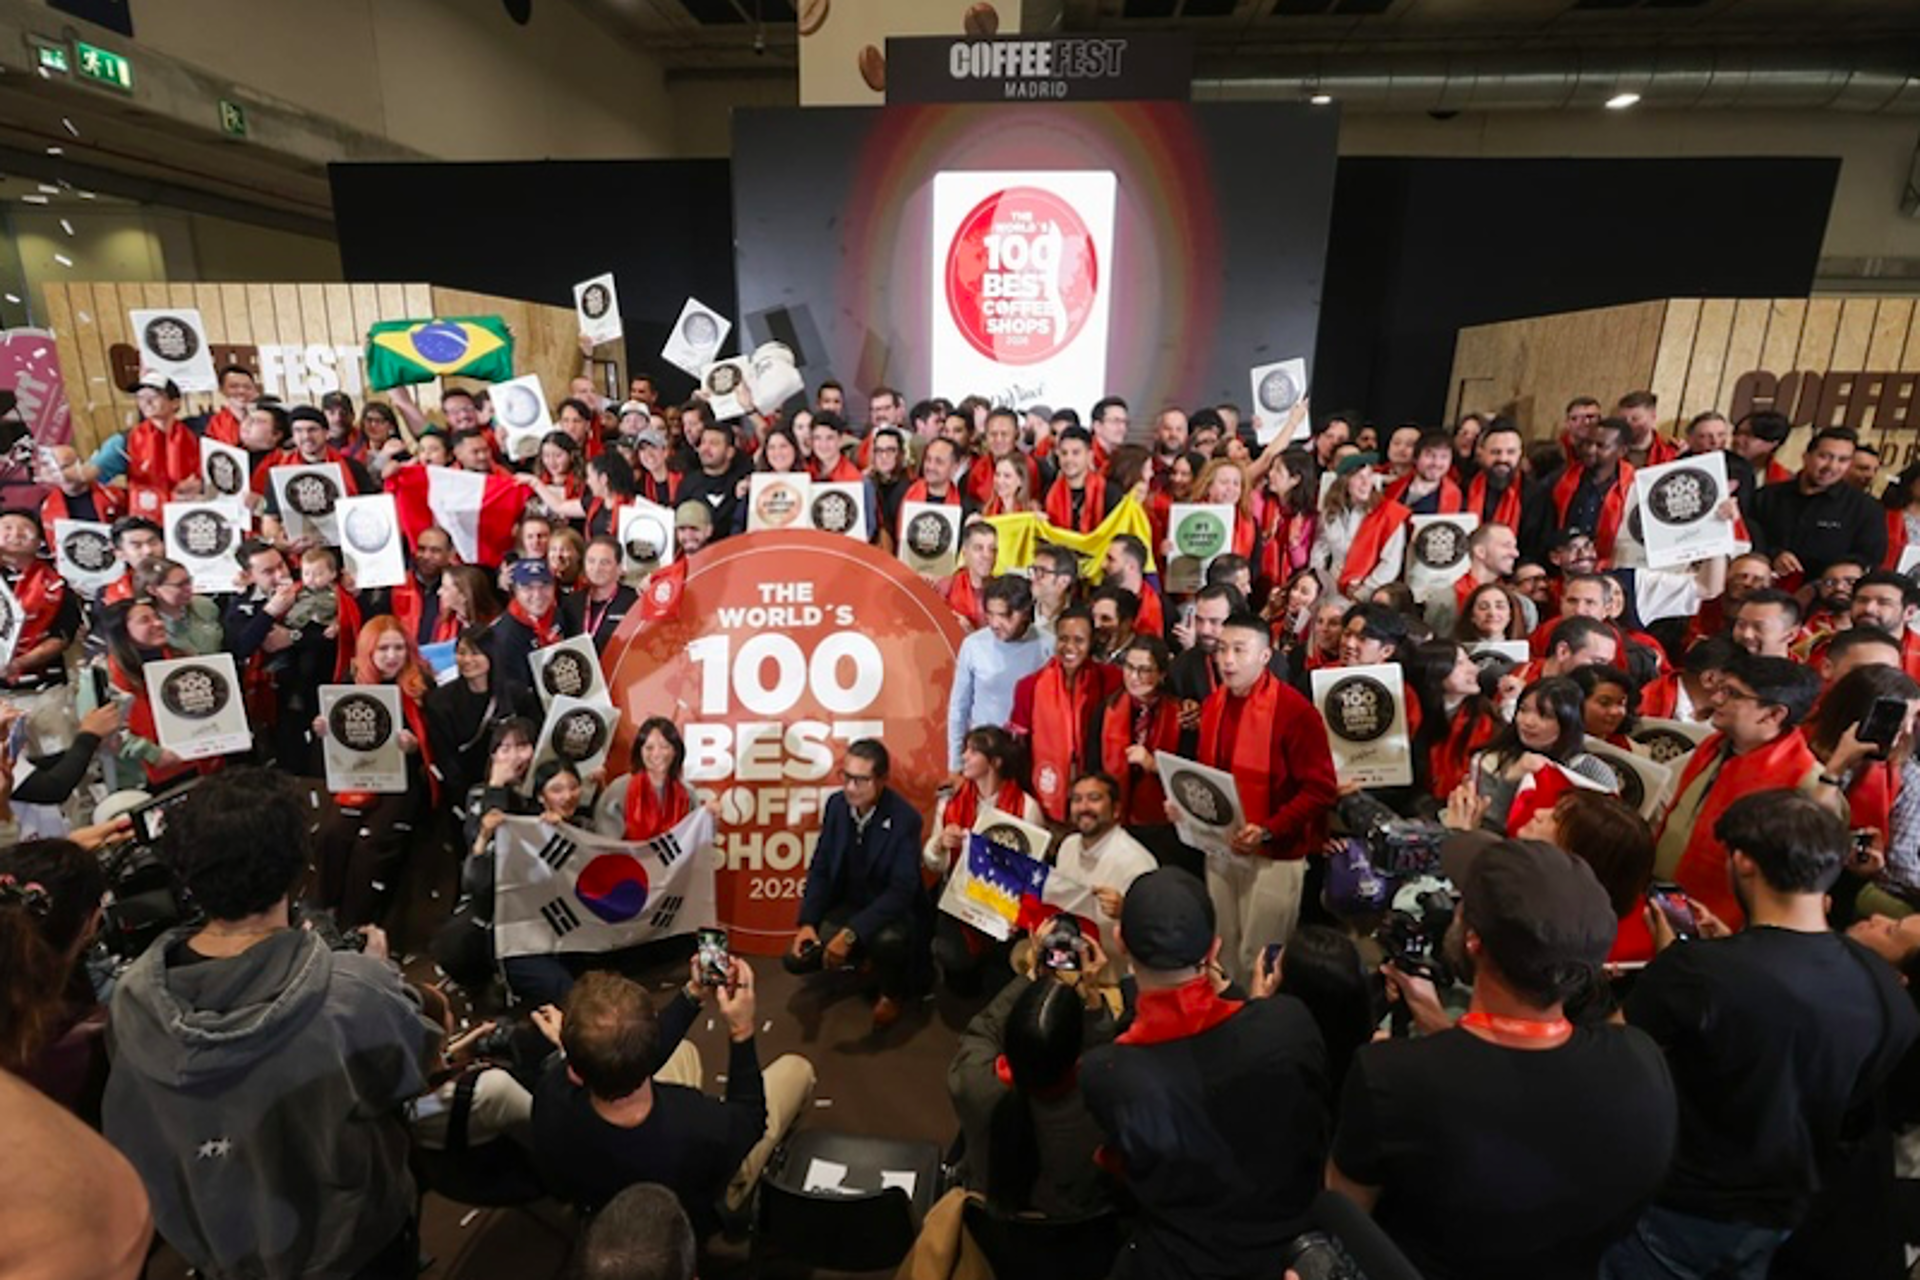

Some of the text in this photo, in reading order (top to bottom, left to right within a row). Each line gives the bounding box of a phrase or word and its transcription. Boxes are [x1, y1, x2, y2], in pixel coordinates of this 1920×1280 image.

[1004, 81, 1068, 98] MADRID
[984, 234, 1054, 271] 100
[983, 274, 1053, 298] BEST
[983, 300, 1055, 317] COFFEE
[986, 318, 1050, 335] SHOPS
[758, 582, 814, 603] THE
[688, 631, 884, 715] 100
[176, 675, 211, 691] 100
[1341, 690, 1376, 708] 100
[343, 707, 376, 721] 100
[684, 720, 884, 781] BEST
